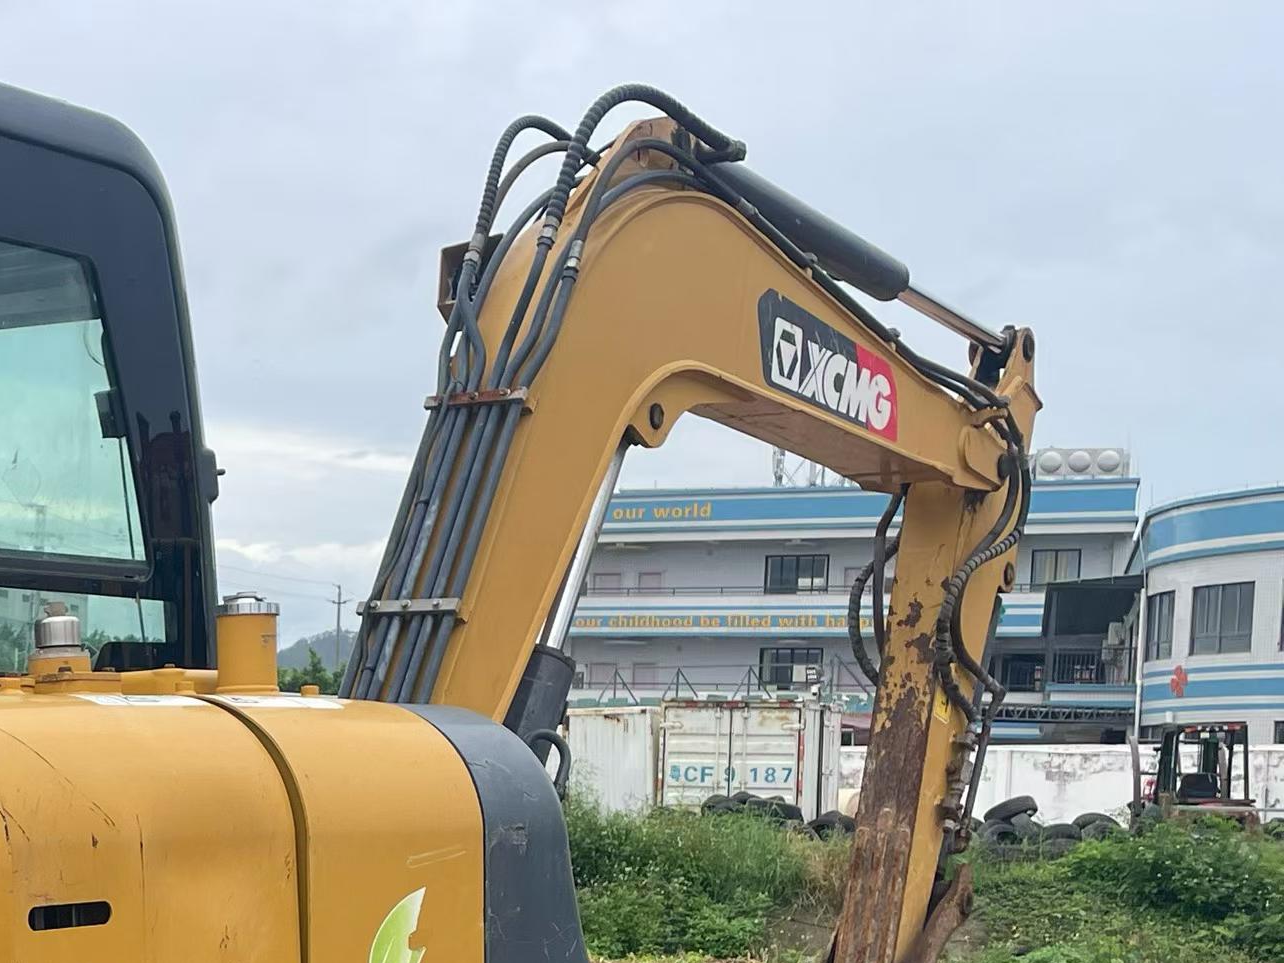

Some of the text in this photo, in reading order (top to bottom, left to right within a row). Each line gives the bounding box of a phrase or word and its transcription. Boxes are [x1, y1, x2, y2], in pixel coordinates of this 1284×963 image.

[798, 339, 892, 431] XCMG
[612, 502, 712, 520] our world
[575, 617, 603, 628] our
[608, 614, 694, 628] childhood
[700, 614, 720, 628] be
[727, 614, 771, 628] filled
[779, 614, 817, 628] with
